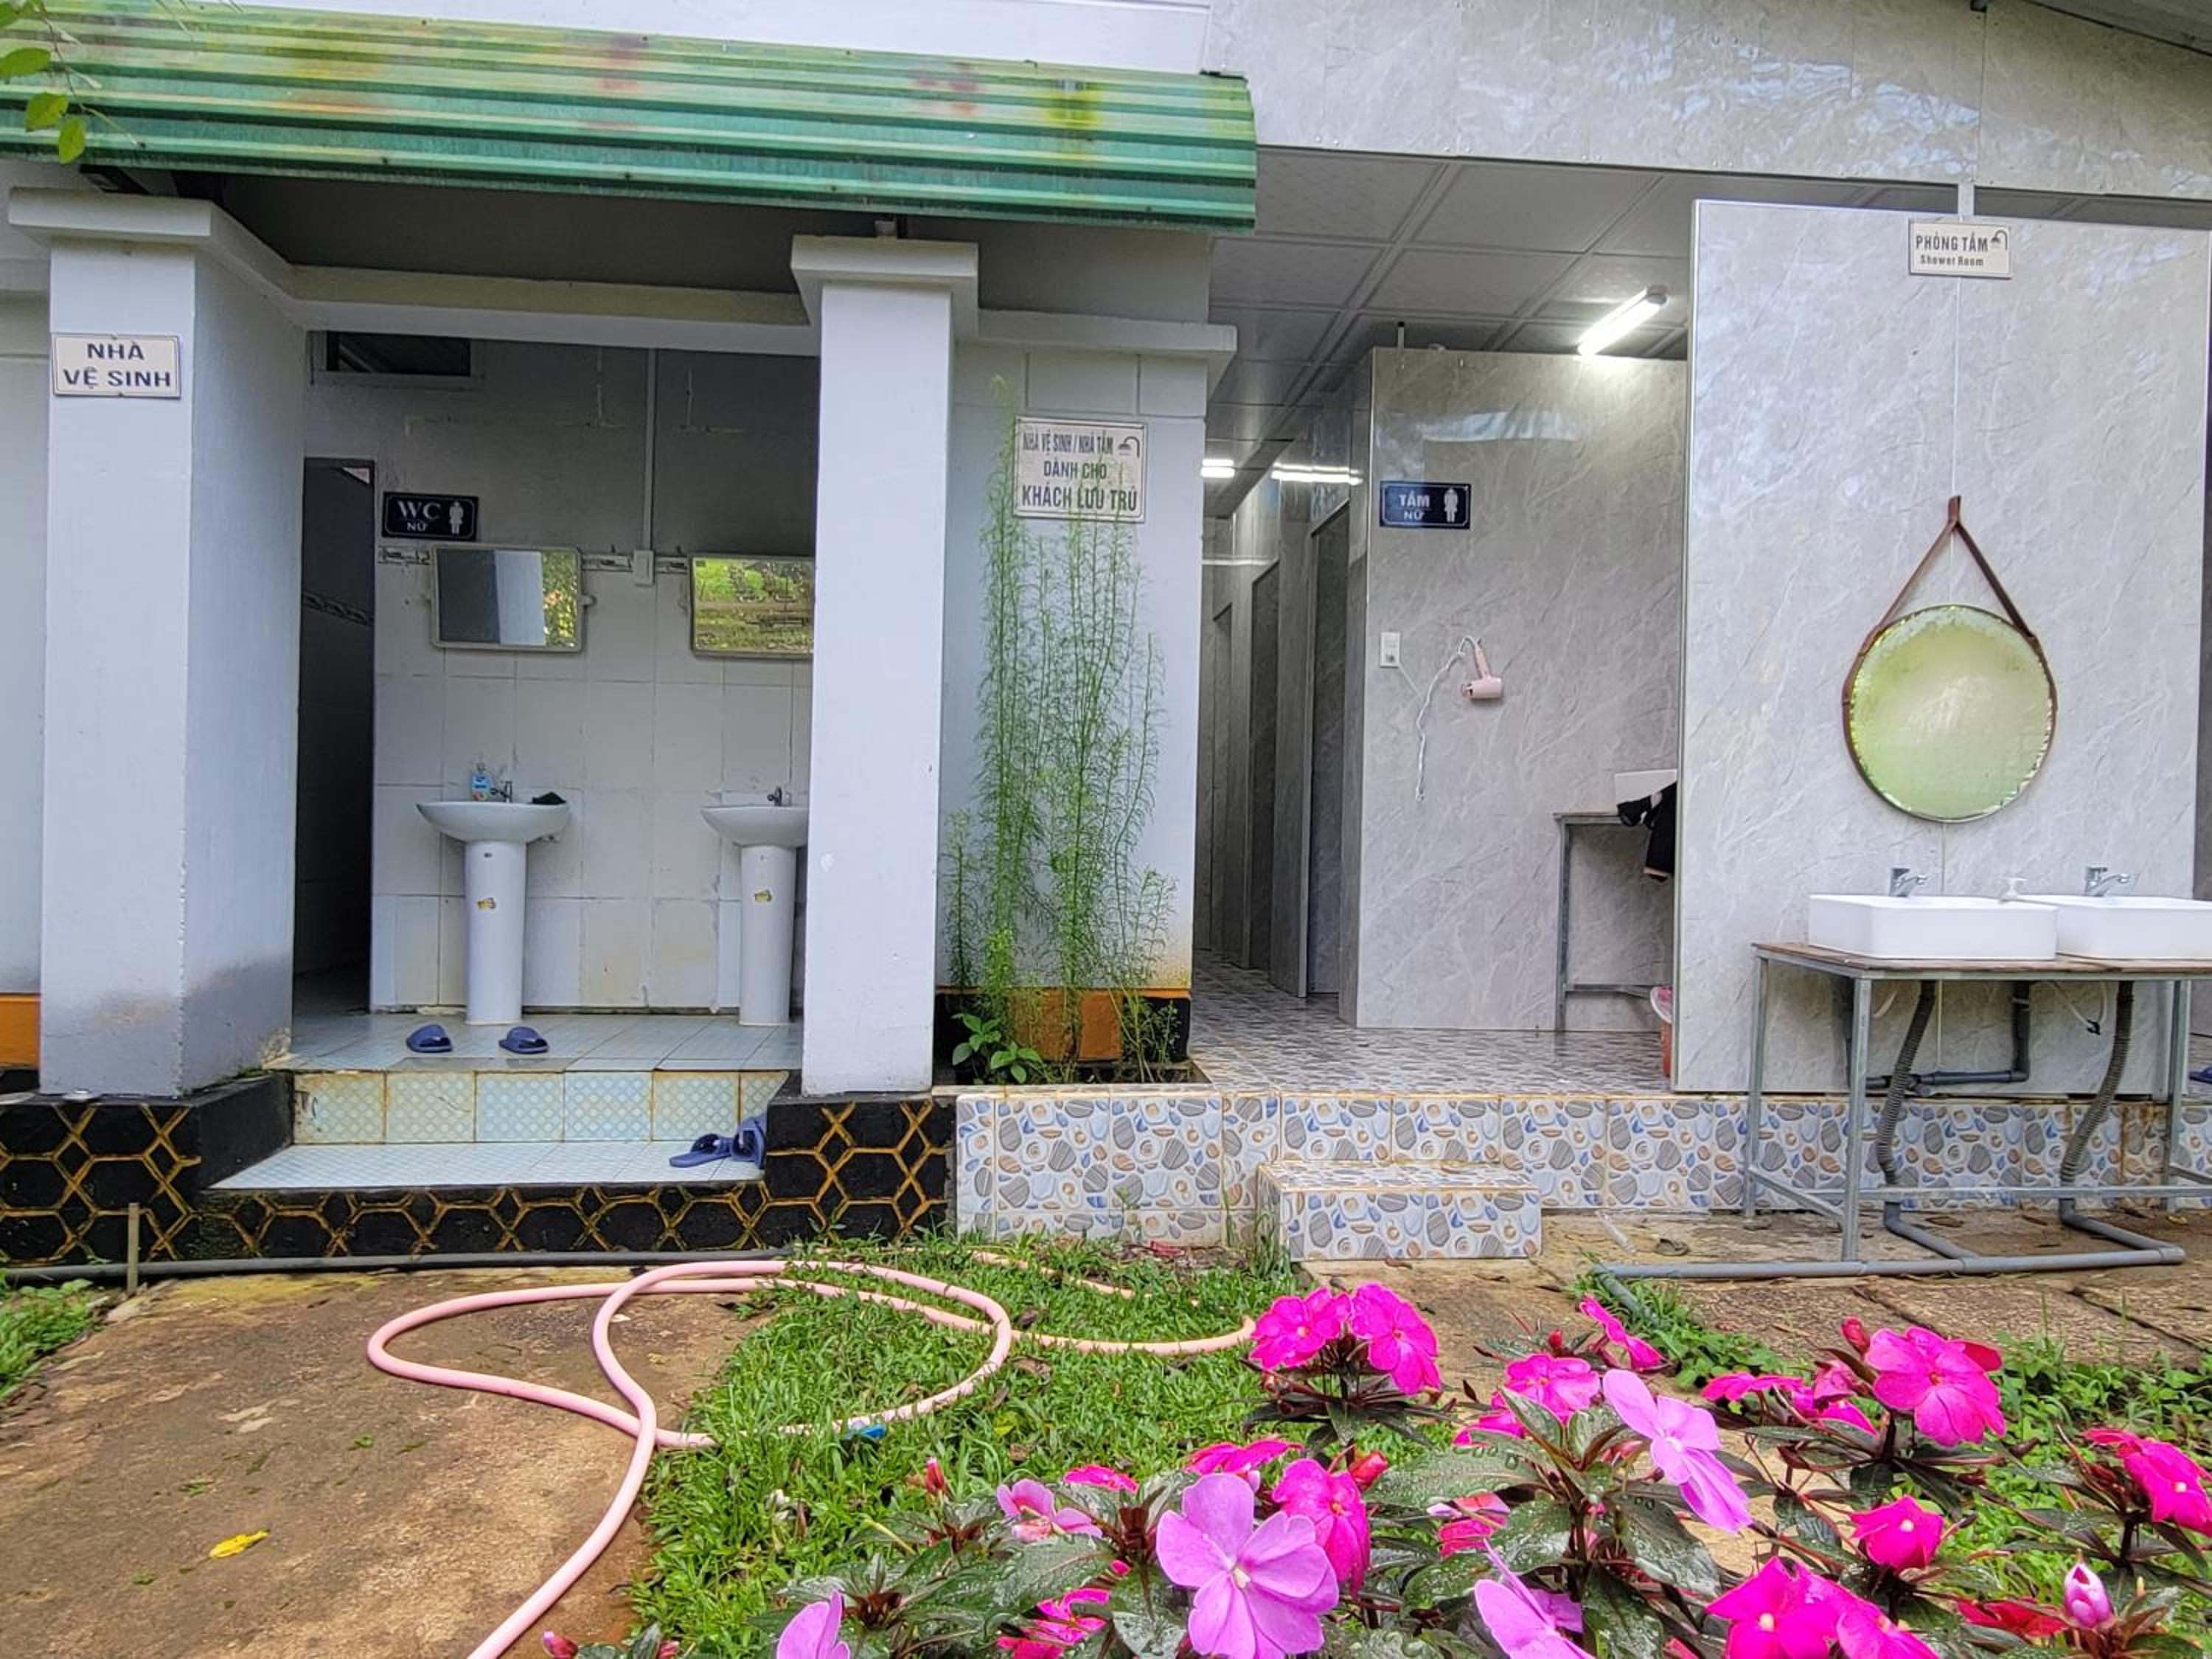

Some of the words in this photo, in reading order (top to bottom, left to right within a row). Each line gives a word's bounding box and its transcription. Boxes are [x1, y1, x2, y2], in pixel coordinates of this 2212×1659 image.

[1916, 231, 1958, 251] PHÒNG
[1920, 254, 1955, 265] Shower
[1958, 256, 1984, 266] Room
[87, 340, 145, 361] NHÀ
[63, 366, 98, 389] VỆ
[107, 370, 171, 386] SINH
[1043, 457, 1078, 478] DÀNH
[1082, 462, 1108, 479] CHO
[1022, 481, 1072, 508] KHÁCH
[1077, 487, 1105, 509] LƯU
[1110, 486, 1138, 511] TRÚ
[398, 501, 440, 519] WC
